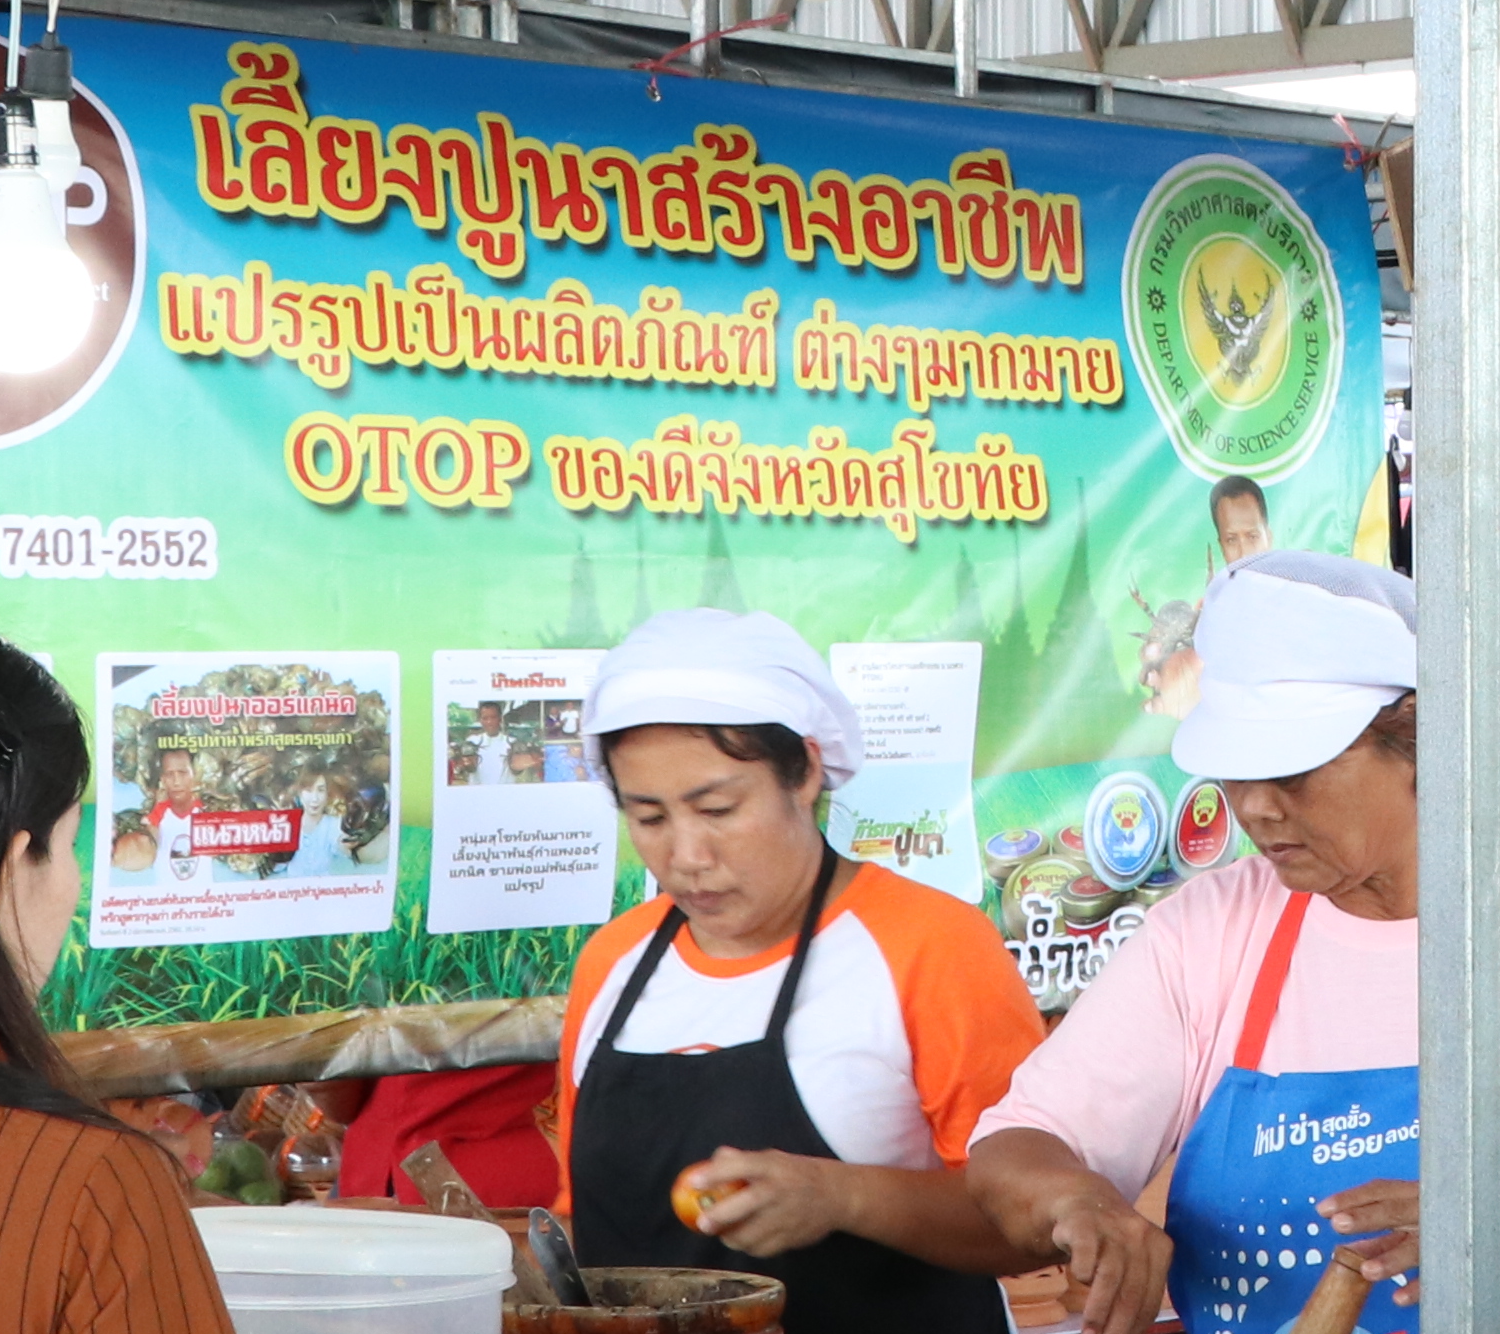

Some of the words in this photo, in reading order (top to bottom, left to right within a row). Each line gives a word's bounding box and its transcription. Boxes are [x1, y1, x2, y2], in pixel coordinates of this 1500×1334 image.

[200, 51, 1080, 275] เลี้ยงปูนาสร้างอาชีพ
[166, 271, 773, 378] แปรรูปเป็นผลิตภัณฑ์
[800, 309, 1118, 403] ต่างๆมากมาย
[1153, 321, 1213, 443] DEPARTMENT
[1214, 434, 1234, 455] OF
[1238, 411, 1299, 456] SCIENCE
[1293, 331, 1319, 417] SERVICE
[291, 423, 523, 497] OTOP
[550, 423, 1043, 532] ของดีจังหวัดสุโขทัย
[1, 525, 209, 569] 7401-2552
[1312, 1132, 1384, 1165] อร่อย
